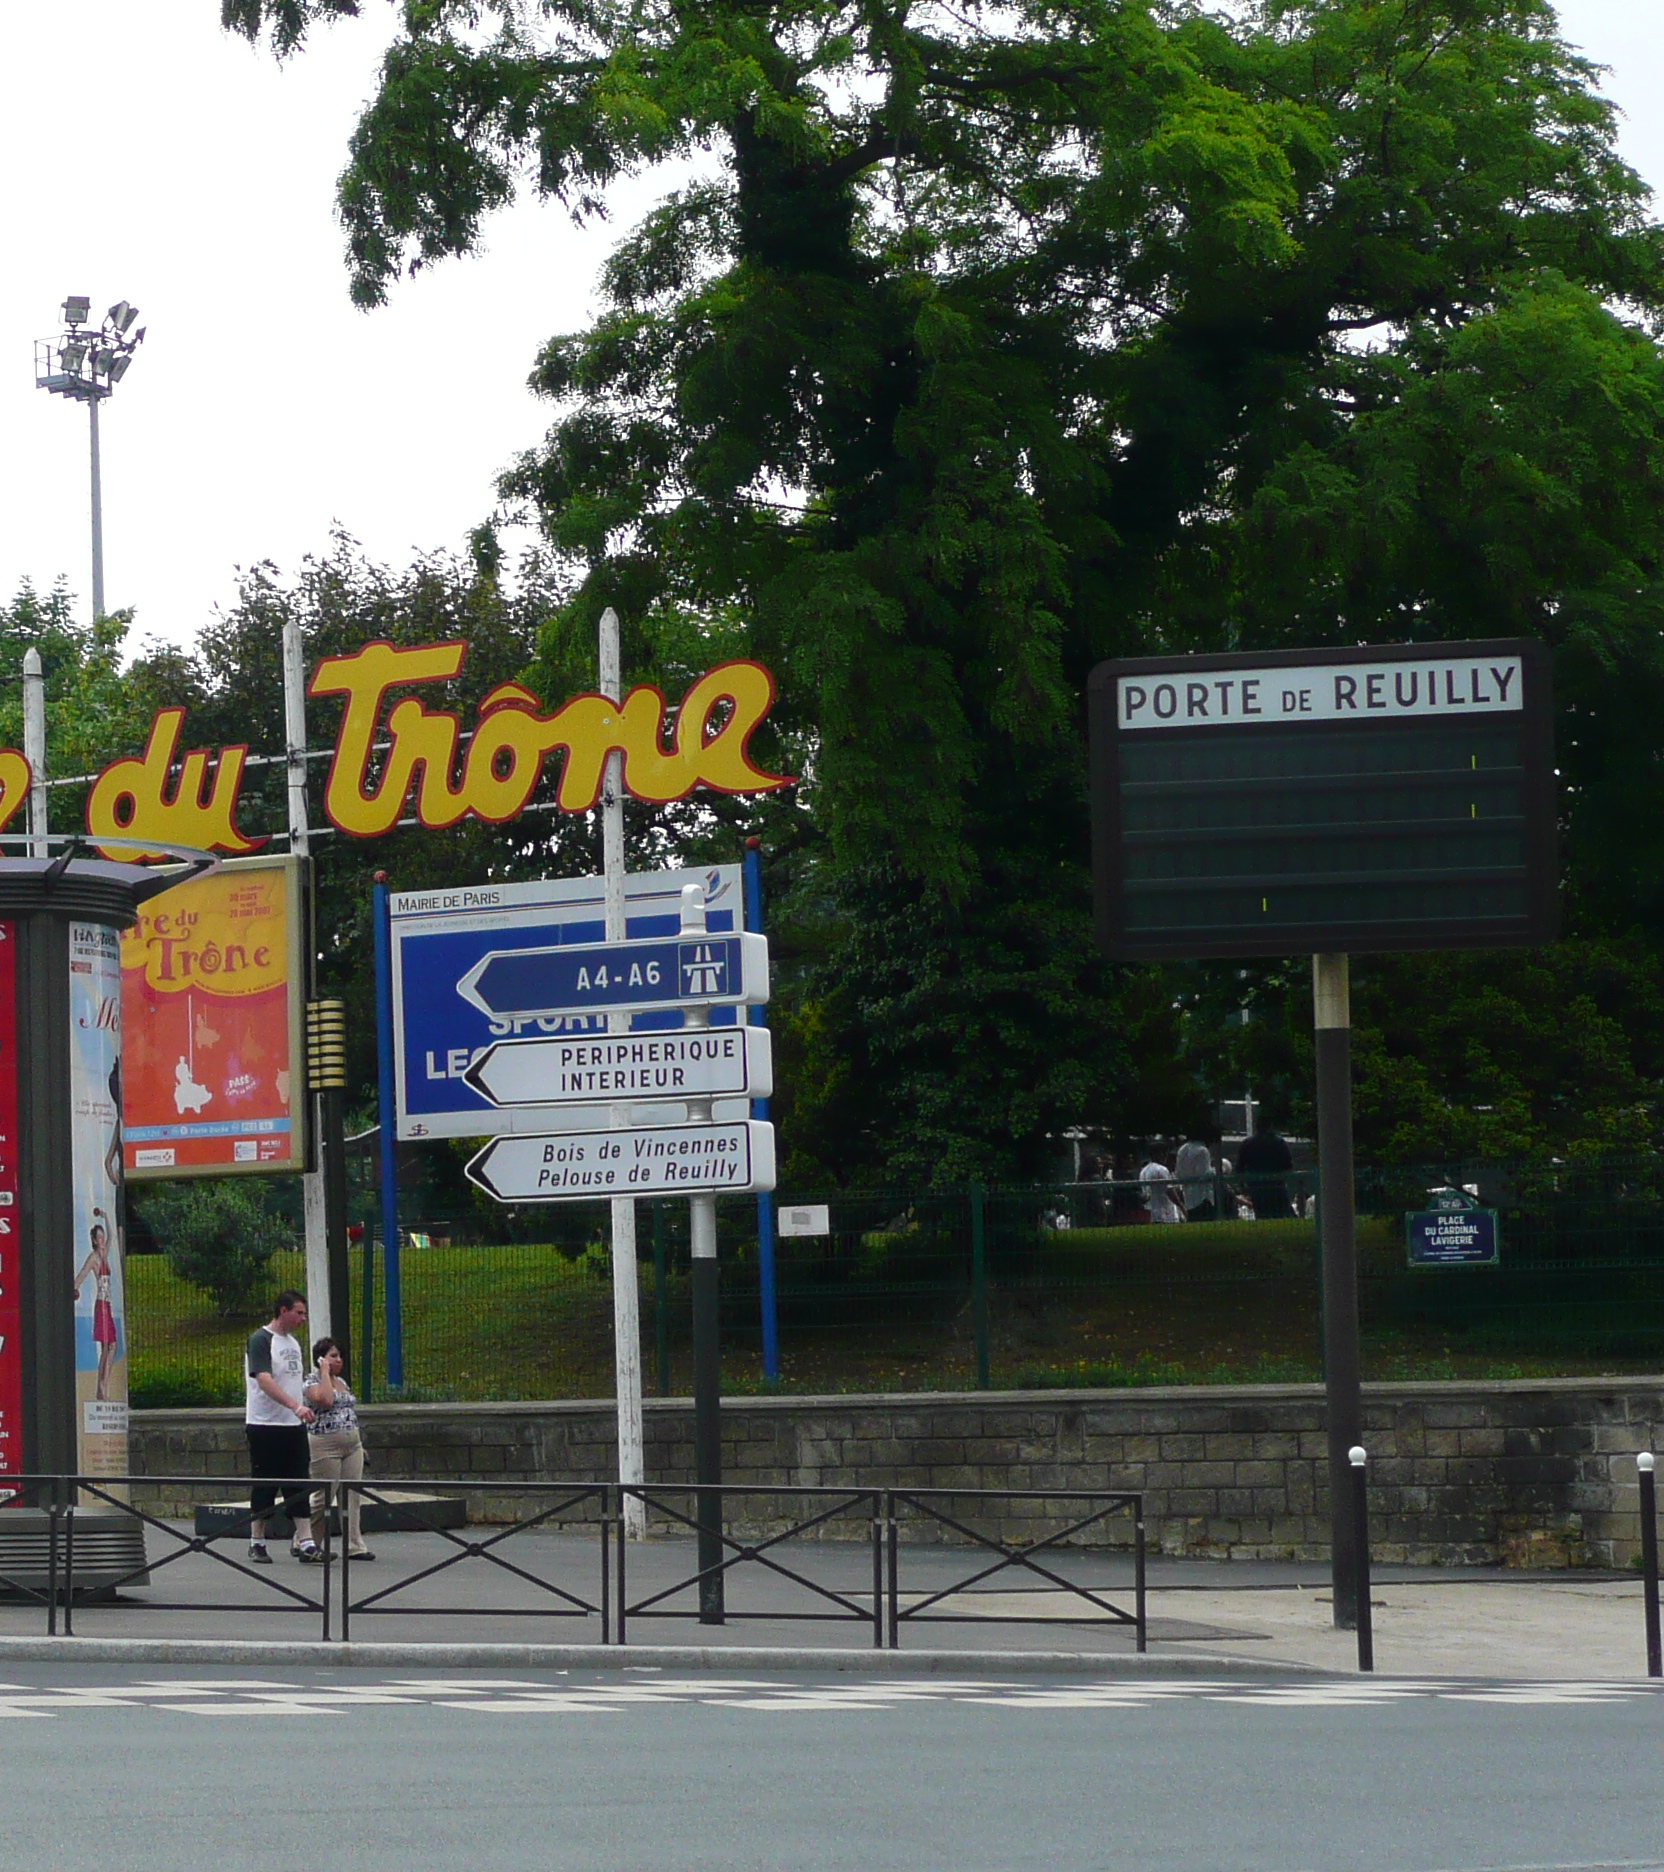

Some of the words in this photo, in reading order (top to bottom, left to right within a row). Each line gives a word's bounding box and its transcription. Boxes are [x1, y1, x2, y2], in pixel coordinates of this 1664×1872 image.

[1124, 678, 1262, 721] PORTE
[1282, 689, 1313, 713] DE
[1334, 666, 1517, 711] REUILLY
[86, 706, 273, 863] du
[306, 639, 798, 838] Trône
[398, 897, 441, 912] MAIRIE
[443, 895, 460, 908] DE
[463, 892, 500, 906] PARIS
[175, 908, 199, 926] du
[146, 927, 271, 981] Trône
[561, 1038, 735, 1067] PERIPHERIQUE
[561, 1067, 685, 1091] INTERIEUR
[543, 1143, 585, 1163] Bois
[598, 1140, 621, 1160] de
[634, 1137, 738, 1158] Vincennes
[538, 1167, 616, 1188] Pelouse
[628, 1164, 651, 1183] de
[664, 1159, 738, 1181] Reuilly
[1425, 1227, 1436, 1236] DU
[1438, 1225, 1479, 1235] CARDINAL
[1438, 1215, 1465, 1225] PLACE
[1431, 1235, 1474, 1245] LAVIGERIE
